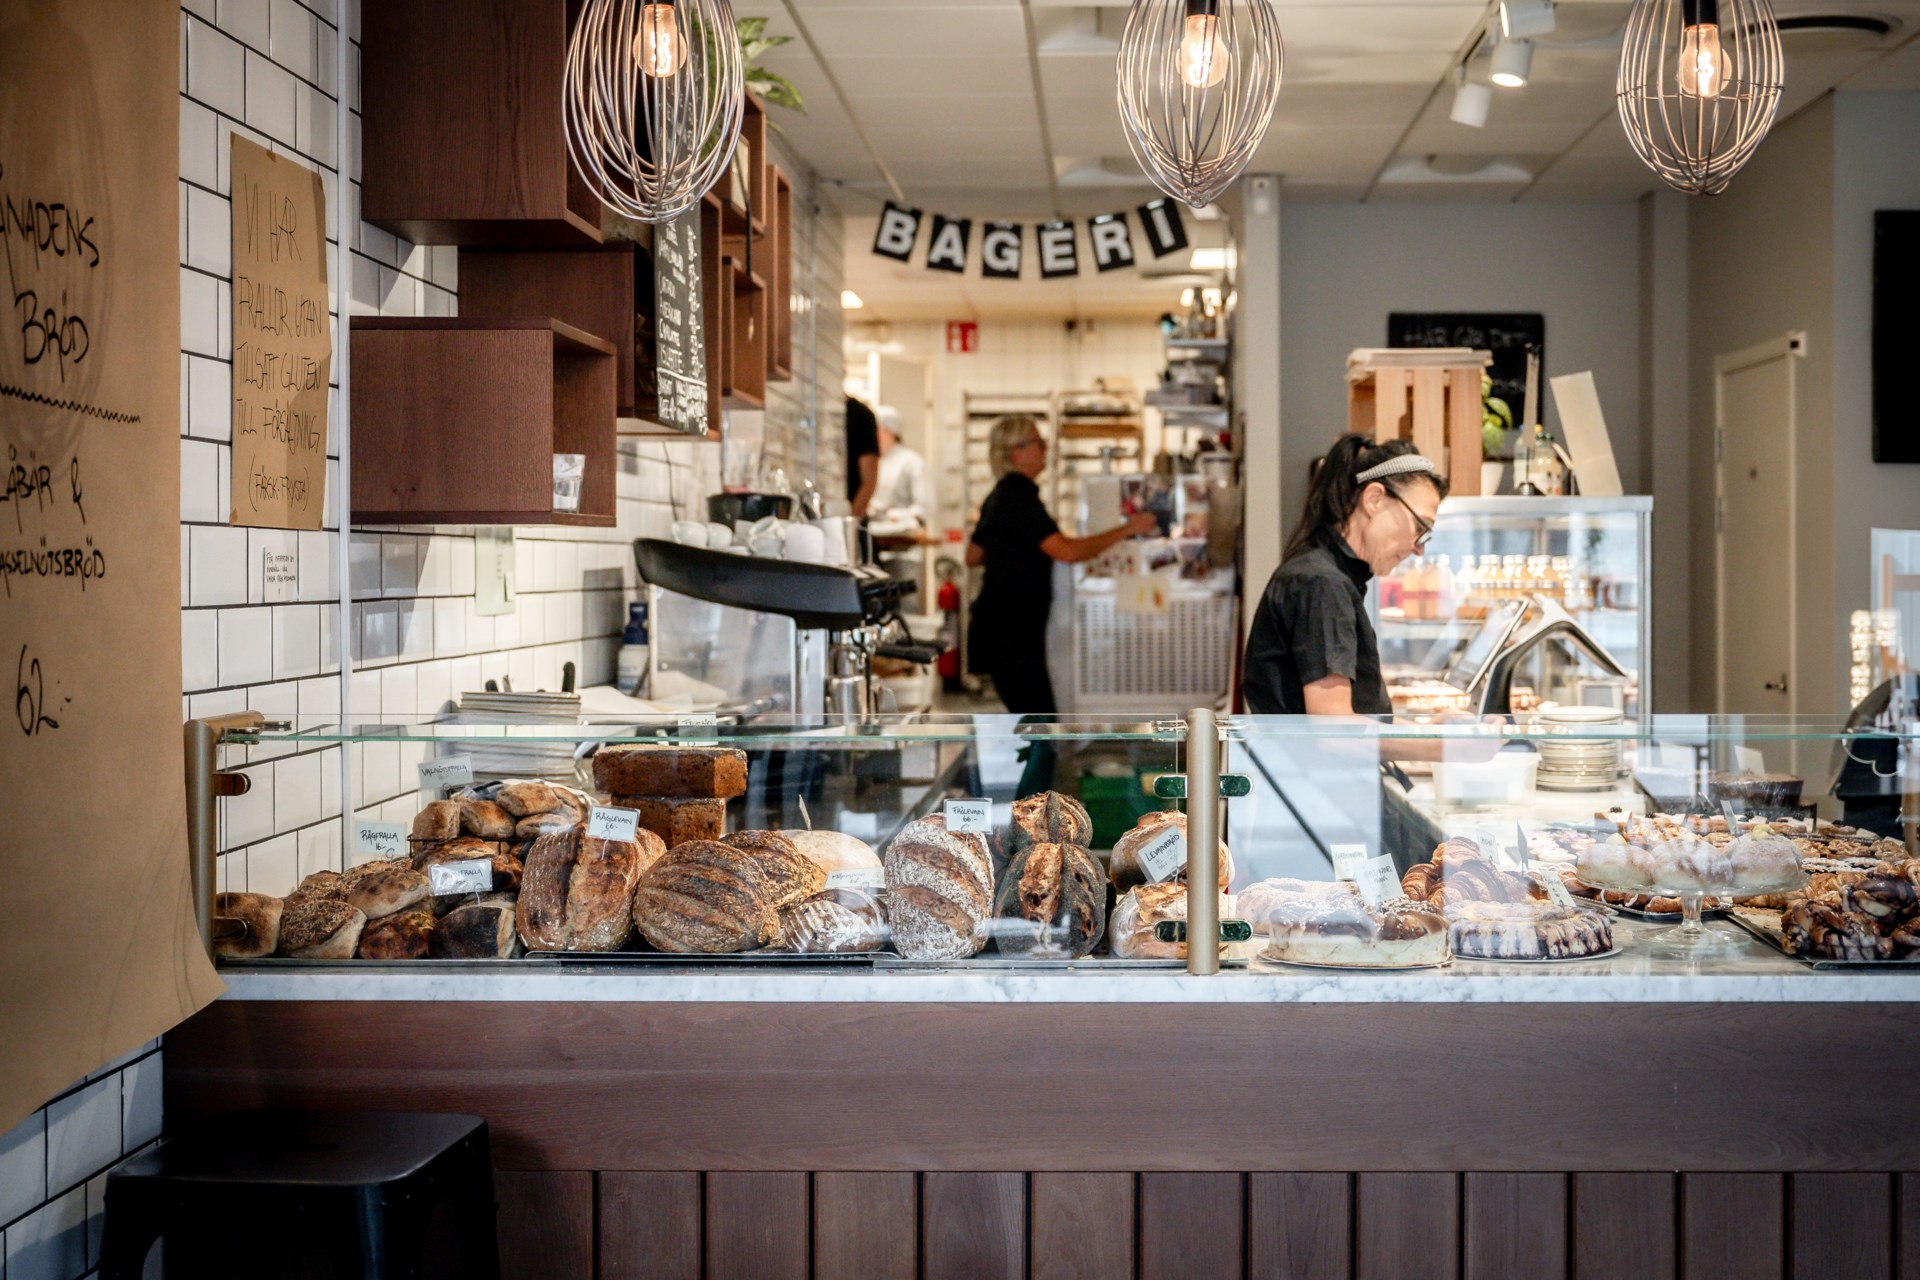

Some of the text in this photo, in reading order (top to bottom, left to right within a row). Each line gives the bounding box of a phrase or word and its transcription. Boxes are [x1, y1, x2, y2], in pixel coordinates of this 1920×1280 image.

[243, 172, 302, 263] VI HAR
[875, 207, 1177, 273] BAGERI
[238, 275, 322, 338] FRALLOR UTAN
[236, 341, 322, 392] TILLSATT GLUTEN
[236, 398, 258, 436] TILL
